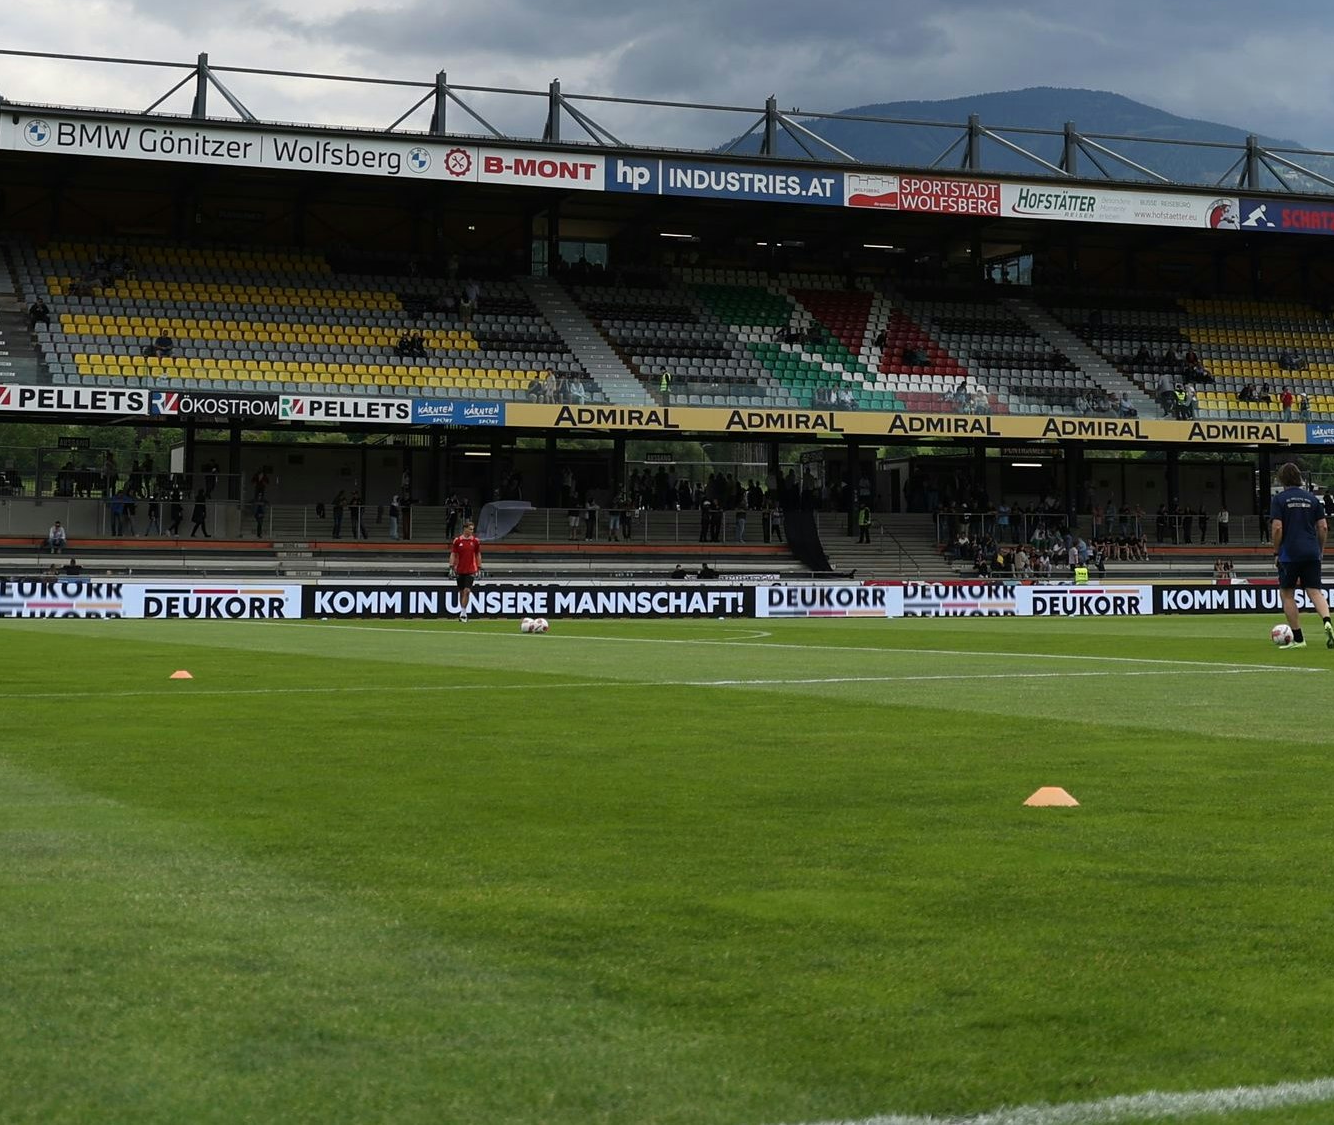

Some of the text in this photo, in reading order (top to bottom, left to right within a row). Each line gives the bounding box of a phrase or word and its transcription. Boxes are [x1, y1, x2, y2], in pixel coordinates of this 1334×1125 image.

[57, 122, 401, 175] BMW Gönitzer Wolfsberg
[483, 156, 597, 181] B-MONT
[617, 159, 835, 198] hp INDUSTRIES.AT
[901, 178, 998, 198] SPORTSTADT
[901, 195, 999, 214] WOLFSBERG
[1017, 188, 1096, 212] HOFSTÄTTER
[1134, 210, 1197, 221] www.hofstaetter.eu
[19, 388, 143, 411] PELLETS
[179, 394, 278, 416] ÖKOSTROM
[309, 399, 410, 420] PELLETS
[554, 405, 679, 429] ADMIRAL
[725, 410, 844, 432] ADMIRAL
[887, 414, 1001, 436] ADMIRAL
[1042, 417, 1149, 439] ADMIRAL
[1188, 422, 1289, 442] ADMIRAL
[315, 591, 744, 615] KOMM IN UNSERE MANNSCHAFT!
[768, 588, 886, 607] DEUKORR
[903, 585, 1016, 599] DEUKORR
[1162, 589, 1230, 610] KOMM
[1235, 589, 1256, 610] IN
[144, 596, 285, 618] DEUKORR
[1033, 595, 1139, 615] DEUKORR
